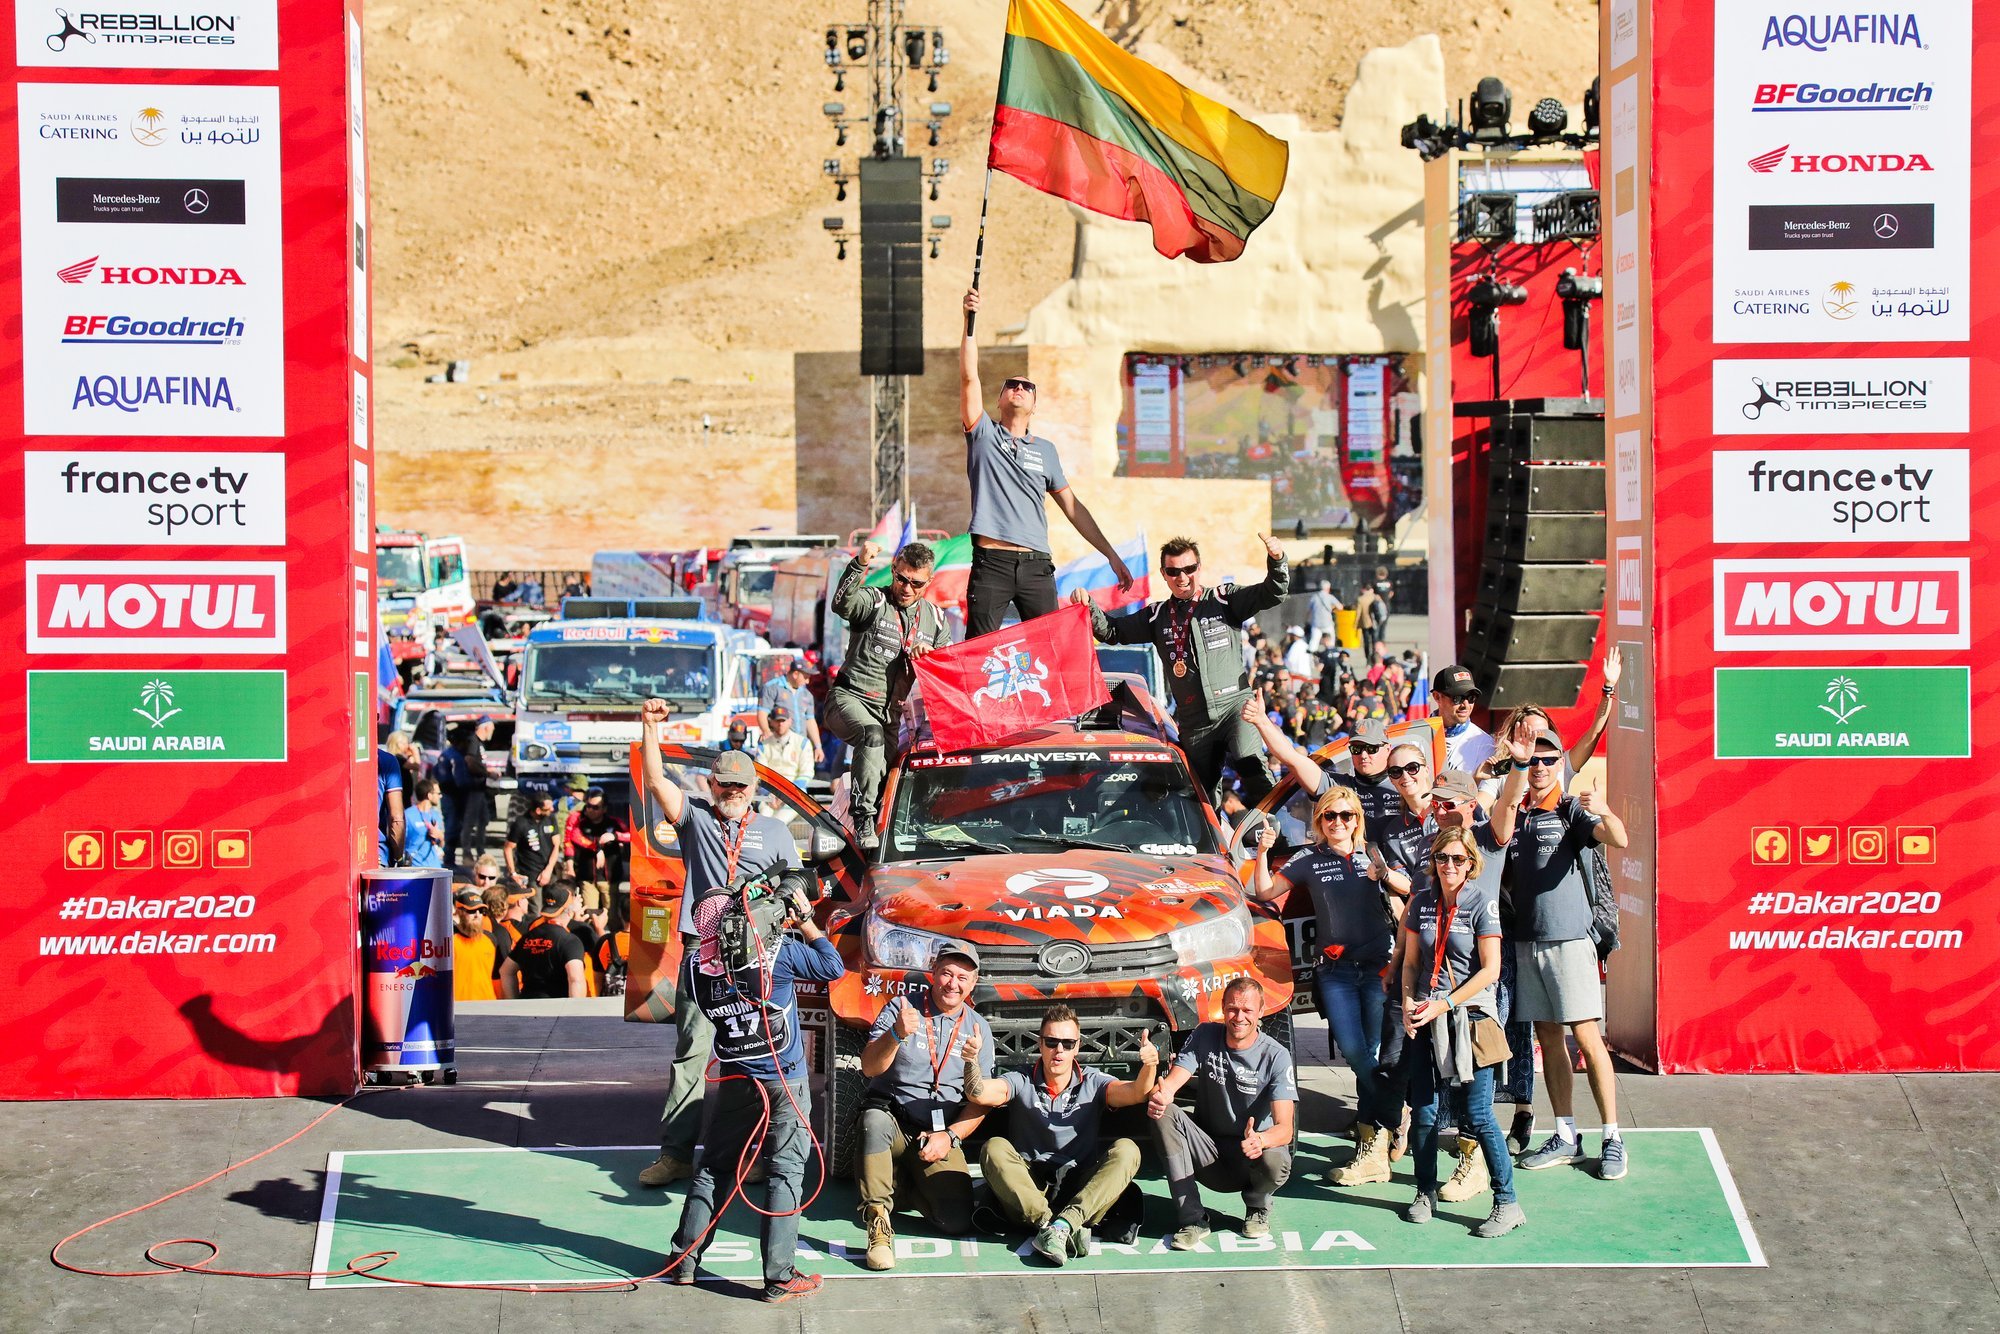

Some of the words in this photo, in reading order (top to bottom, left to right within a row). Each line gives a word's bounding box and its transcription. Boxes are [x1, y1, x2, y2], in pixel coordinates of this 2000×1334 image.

[1762, 13, 1923, 52] AQUAFINA
[1754, 82, 1933, 104] BFGoodrich
[40, 112, 71, 121] SAUDI
[74, 113, 118, 121] AIRLINES
[181, 114, 225, 124] السعودية
[229, 114, 259, 124] الخطوط
[39, 124, 118, 140] CATERING
[1790, 154, 1935, 172] HONDA
[93, 193, 161, 205] Mercedes-Benz
[1784, 220, 1851, 231] Mercedes-Benz
[100, 266, 247, 286] HONDA
[1734, 288, 1764, 296] SAUDI
[1768, 288, 1810, 296] AIRLINES
[1871, 287, 1916, 297] السعودية
[1919, 287, 1950, 296] الخطوط
[1733, 301, 1810, 315] CATERING
[64, 315, 244, 337] BFGoodrich
[223, 337, 241, 345] Tires
[72, 375, 235, 412] AQUAFINA
[148, 499, 246, 536] sport
[1833, 494, 1931, 533] sport
[48, 583, 265, 629] MOTUL
[1734, 580, 1949, 626] MOTUL
[564, 628, 595, 639] Red
[595, 627, 626, 639] Bull
[89, 735, 147, 751] SAUDI
[152, 735, 225, 751] ARABIA
[1775, 732, 1832, 748] SAUDI
[1837, 732, 1910, 747] ARABIA
[994, 751, 1102, 763] MANVESTA
[1110, 753, 1171, 761] TRYGG
[1537, 845, 1559, 853] ABOUT
[1320, 860, 1342, 868] KREDA
[59, 895, 256, 920] #Dakar2020
[1747, 891, 1942, 915] #Dakar2020
[1004, 905, 1124, 922] VIADA
[39, 931, 277, 956] www.dakar.com
[1729, 926, 1963, 950] www.dakar.com
[377, 937, 417, 960] Red
[421, 937, 451, 959] Bull
[886, 980, 930, 995] KRED
[706, 1000, 754, 1020] PODIUM
[724, 1011, 760, 1038] 17
